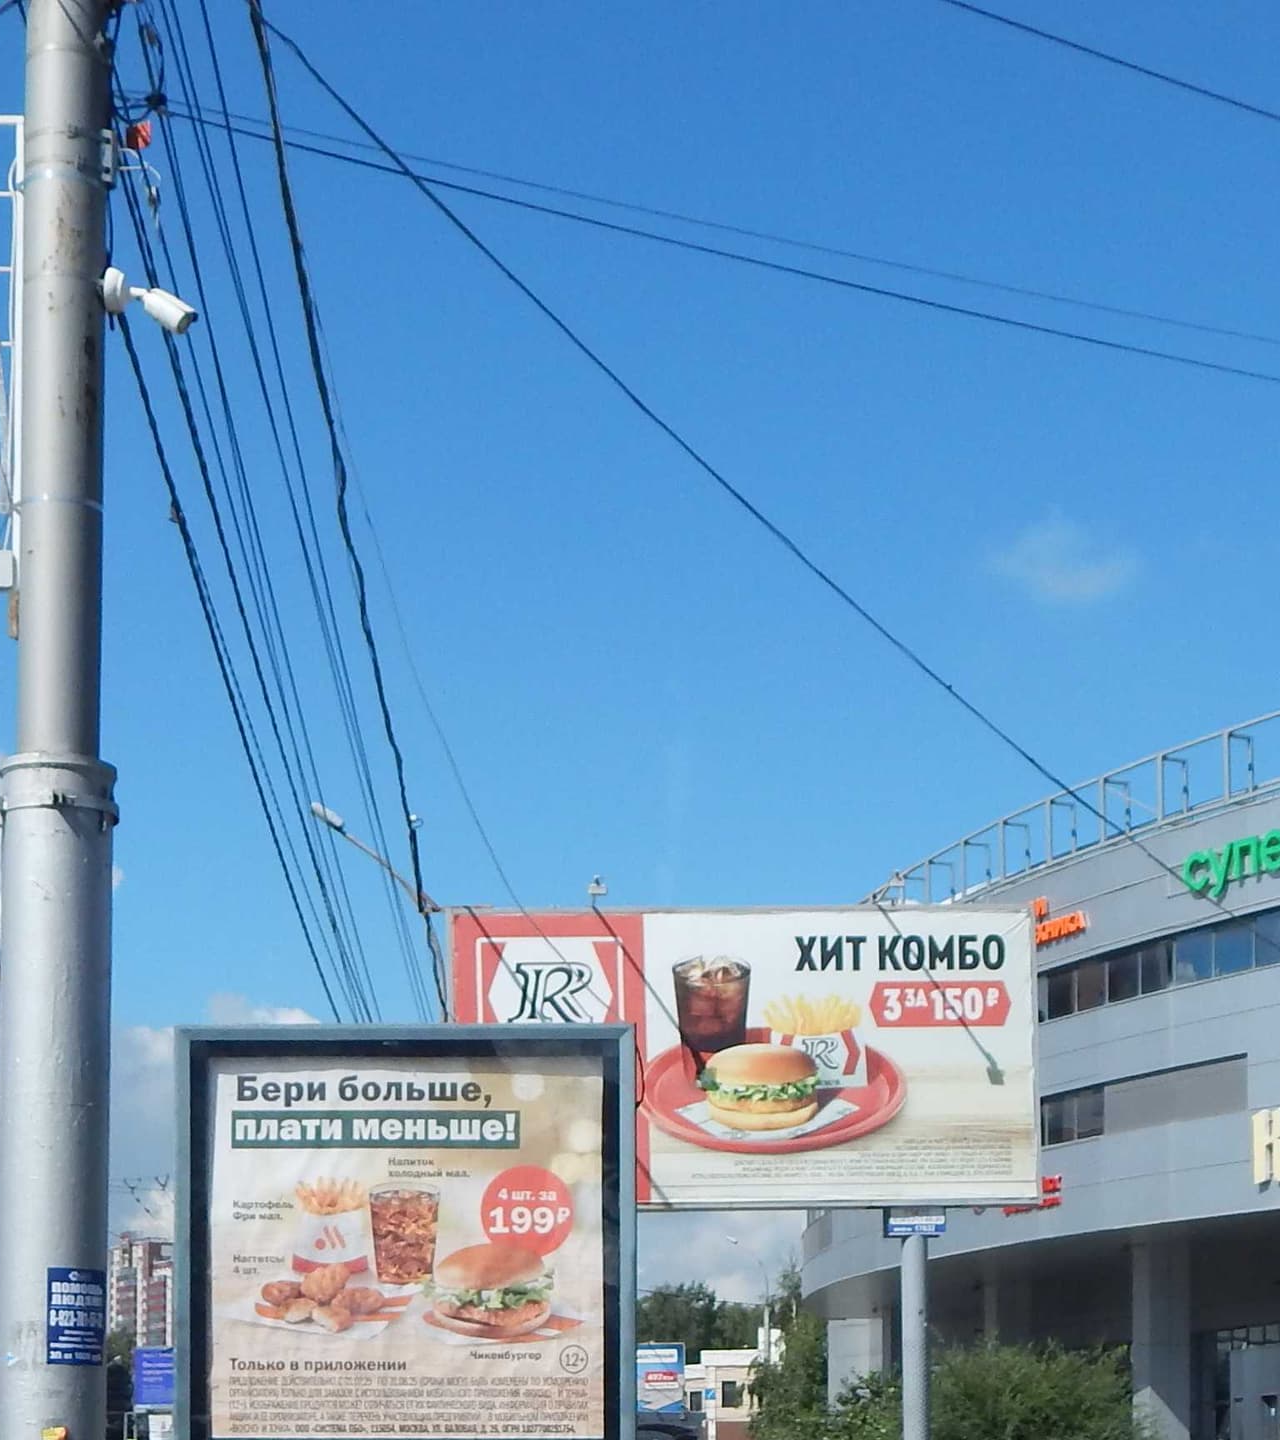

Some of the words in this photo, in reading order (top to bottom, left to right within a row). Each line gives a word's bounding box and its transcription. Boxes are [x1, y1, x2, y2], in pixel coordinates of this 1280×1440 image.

[794, 936, 867, 971] ХИТ
[878, 934, 1006, 971] КОМБО
[236, 1075, 327, 1108] Бери
[338, 1075, 492, 1107] больше,
[234, 1117, 342, 1142] плати
[352, 1113, 517, 1142] меньше!
[388, 1157, 435, 1167] Напиток
[388, 1168, 443, 1180] холодный
[498, 1188, 508, 1200] 4
[511, 1190, 535, 1202] шт.
[538, 1190, 557, 1200] за
[233, 1200, 294, 1212] Картофель
[469, 1350, 542, 1361] Чикенбургер
[564, 1352, 587, 1367] 12+
[229, 1358, 285, 1371] Только
[290, 1360, 299, 1371] в
[304, 1360, 407, 1374] приложении
